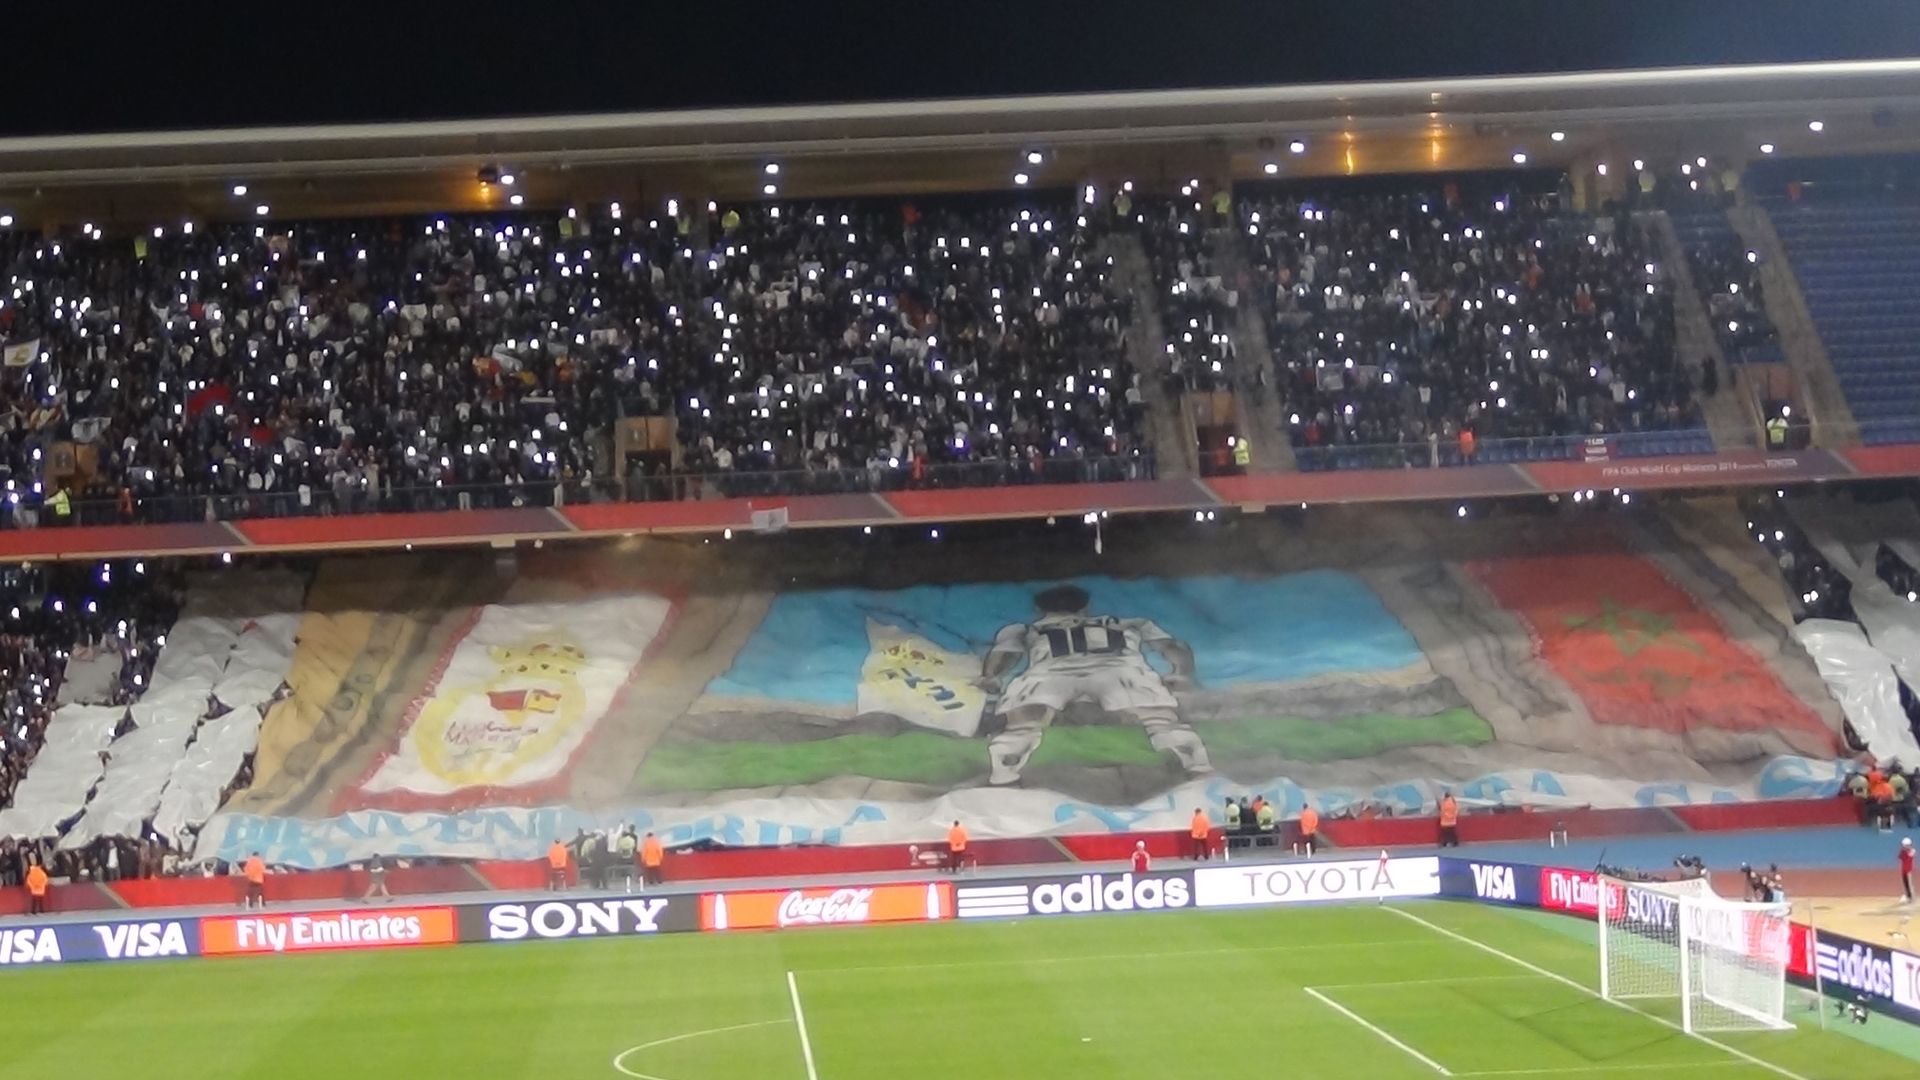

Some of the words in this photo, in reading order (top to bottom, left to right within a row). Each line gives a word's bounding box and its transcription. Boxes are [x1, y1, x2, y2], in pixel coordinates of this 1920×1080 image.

[1039, 625, 1128, 658] 10
[1032, 873, 1189, 913] adidas
[1243, 866, 1395, 897] TOYOTA
[1470, 864, 1516, 900] VISA
[1550, 873, 1572, 907] Fly
[488, 899, 667, 938] SONY
[1627, 887, 1672, 928] SONY
[0, 928, 62, 963] ISA
[92, 922, 188, 958] VISA
[236, 918, 287, 951] Fly
[291, 913, 421, 944] Emirates
[1838, 943, 1892, 998] adidas
